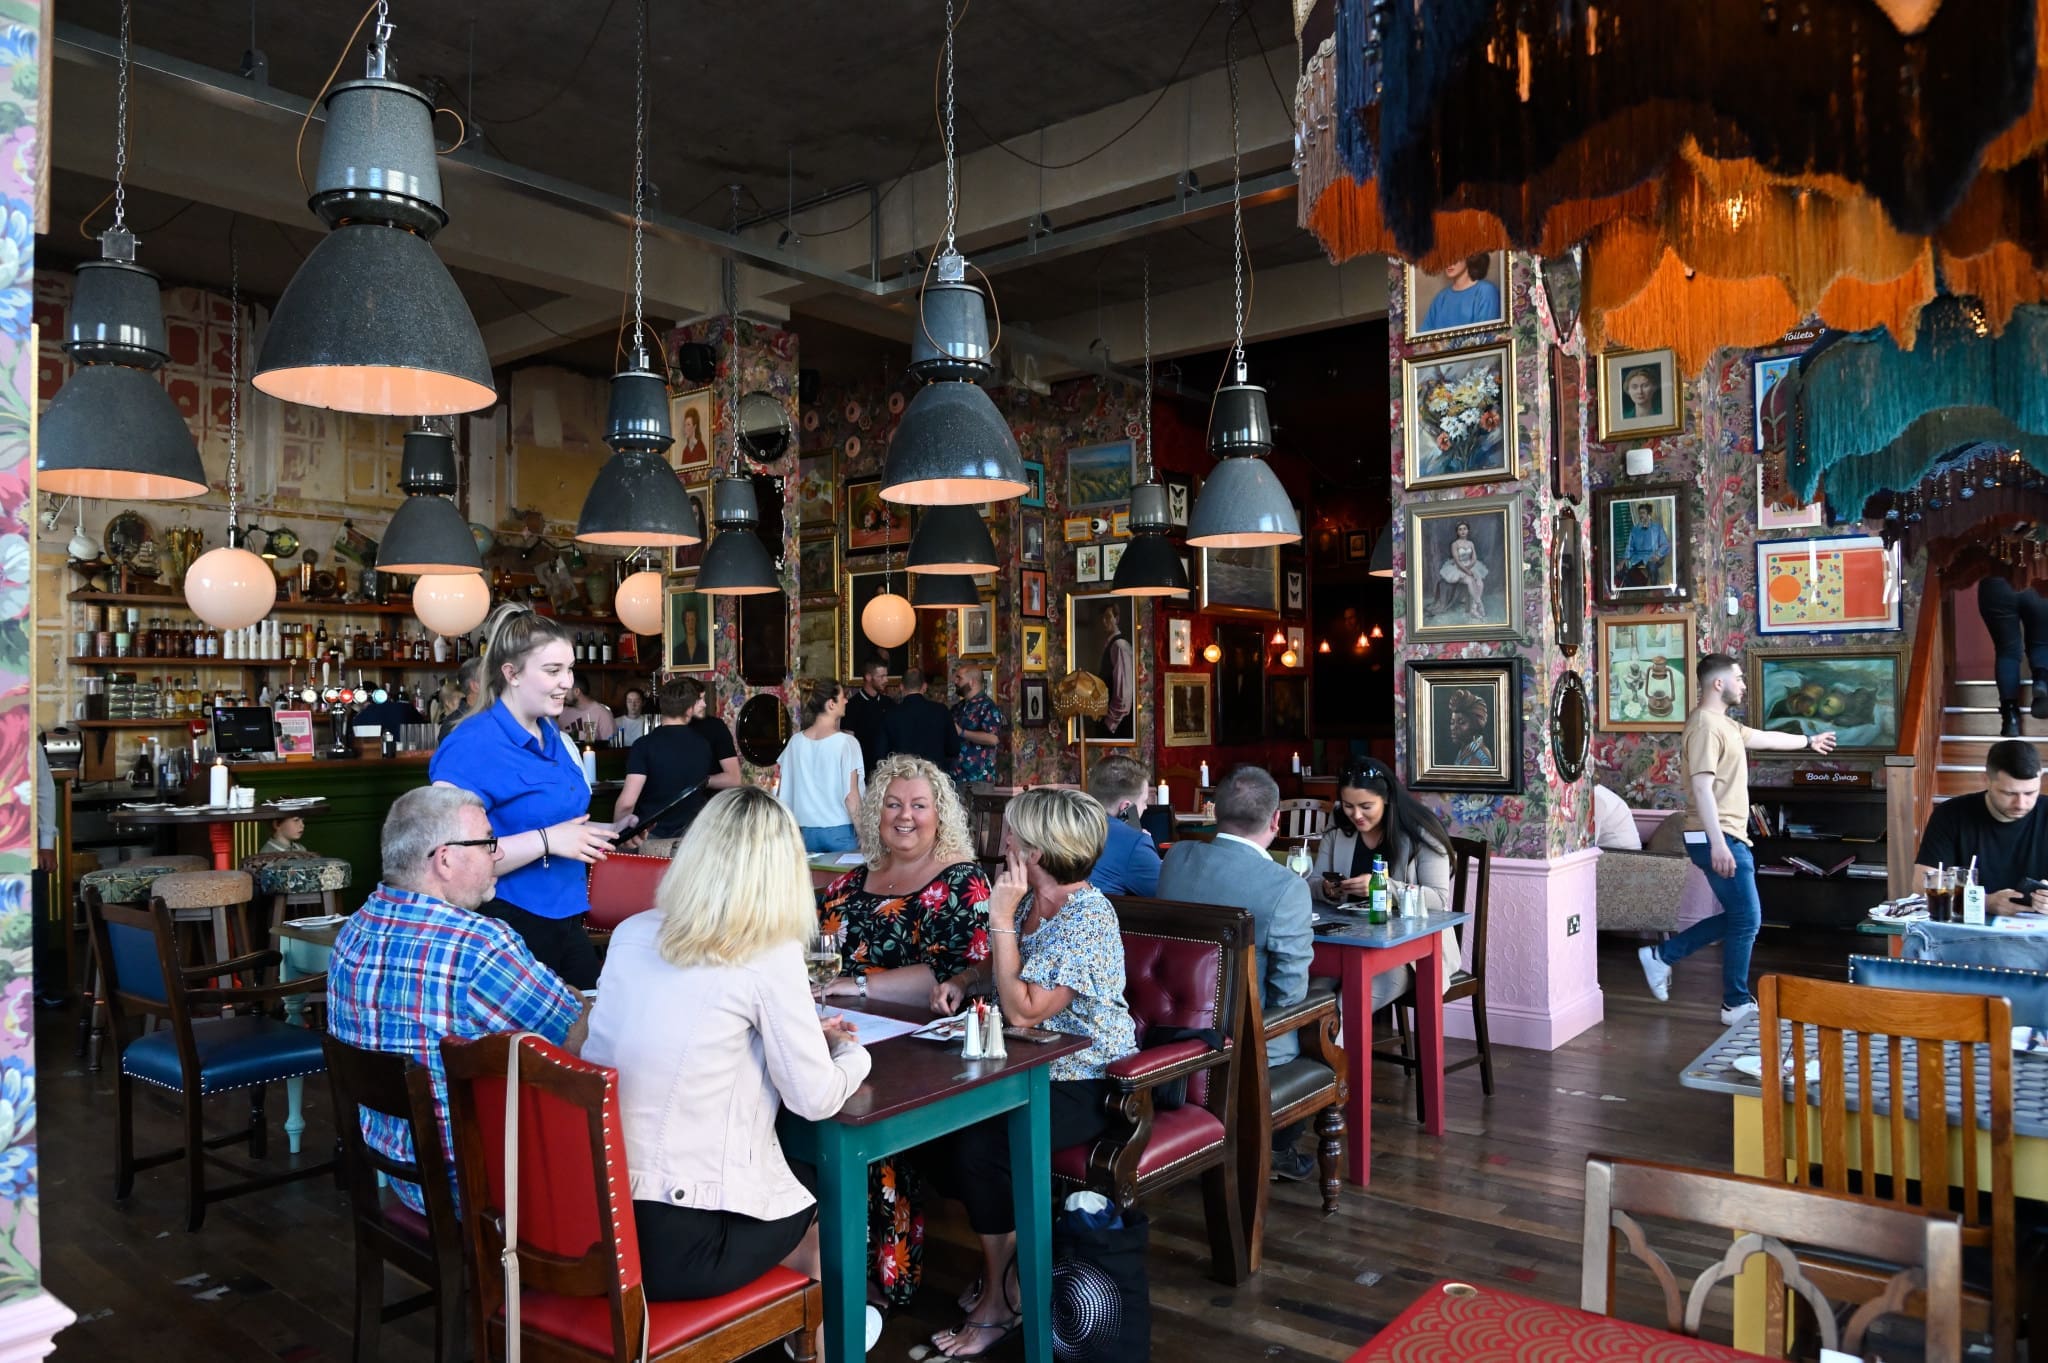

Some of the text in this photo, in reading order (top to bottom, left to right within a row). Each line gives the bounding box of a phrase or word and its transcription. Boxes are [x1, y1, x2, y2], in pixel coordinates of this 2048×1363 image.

[1783, 331, 1814, 341] Toilets
[1805, 772, 1858, 782] Book Swap
